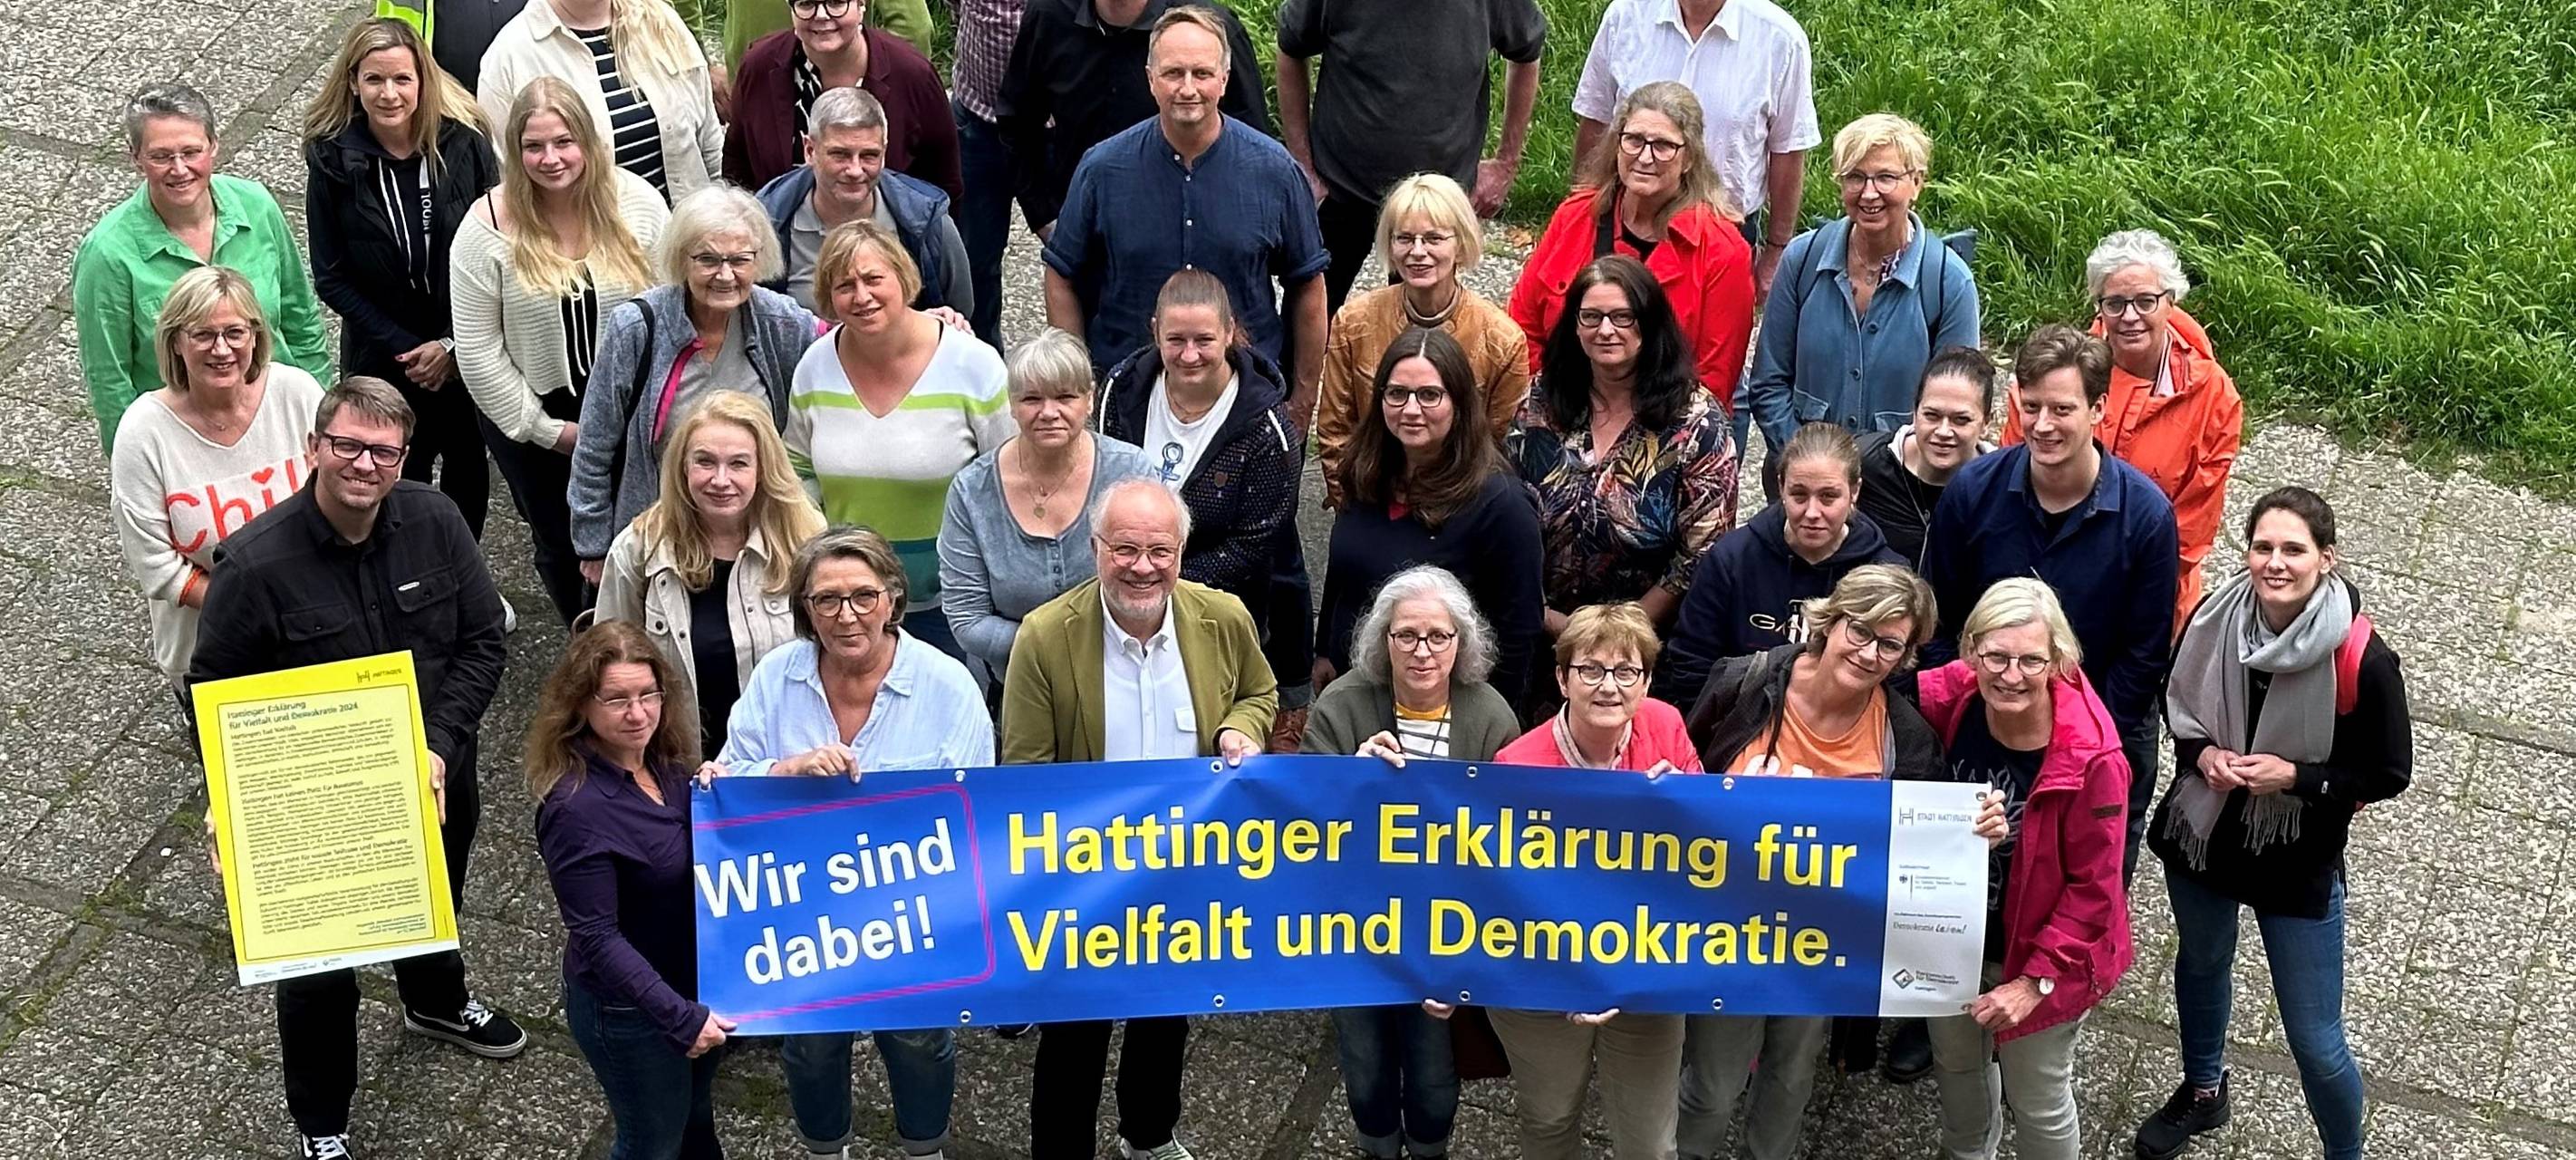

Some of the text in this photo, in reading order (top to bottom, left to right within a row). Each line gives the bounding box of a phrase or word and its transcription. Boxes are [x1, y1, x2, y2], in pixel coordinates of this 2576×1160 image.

[166, 455, 312, 554] Chil
[273, 713, 289, 722] und
[291, 707, 337, 719] Demokratie
[339, 701, 358, 711] 2024
[693, 817, 956, 919] Wir sind
[1008, 803, 1857, 889] Hattinger Erklärung für
[743, 895, 936, 985] dabei!
[1007, 898, 1848, 971] Vielfalt und Demokratie.
